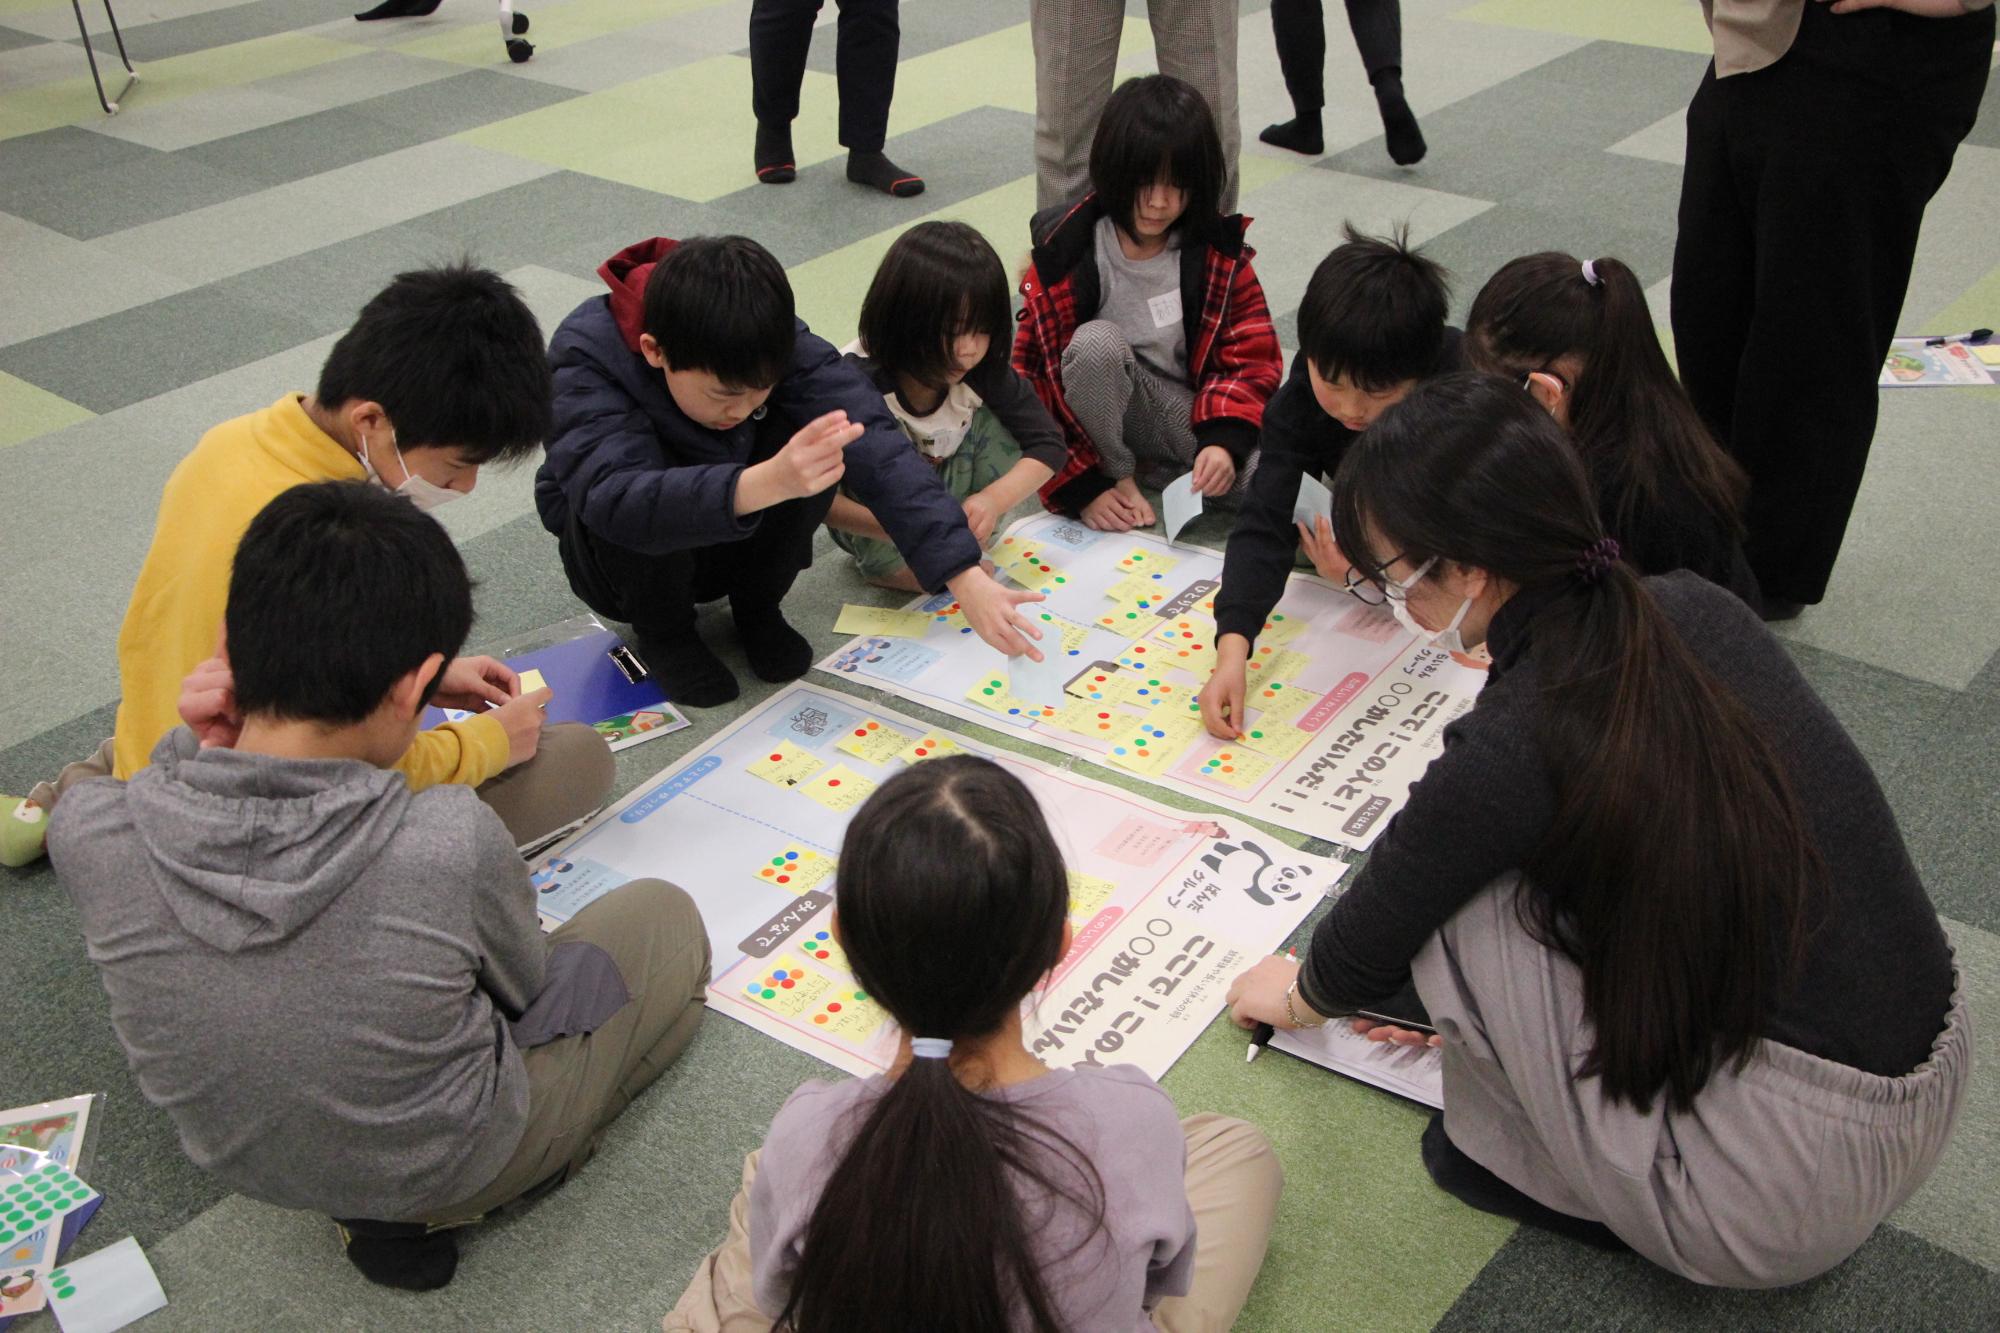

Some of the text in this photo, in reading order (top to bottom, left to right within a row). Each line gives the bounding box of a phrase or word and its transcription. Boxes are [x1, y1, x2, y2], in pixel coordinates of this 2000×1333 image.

[1168, 586, 1209, 616] ひとりで
[1402, 648, 1433, 675] グループ
[1418, 653, 1449, 679] らいおん
[1322, 691, 1450, 812] ここで！この人と！
[1344, 799, 1385, 835] ほんとはね！
[1168, 870, 1204, 909] グループ
[1187, 884, 1221, 913] ぱんだ
[756, 901, 816, 947] みんなで
[1032, 919, 1173, 1064] ○○がしたいん
